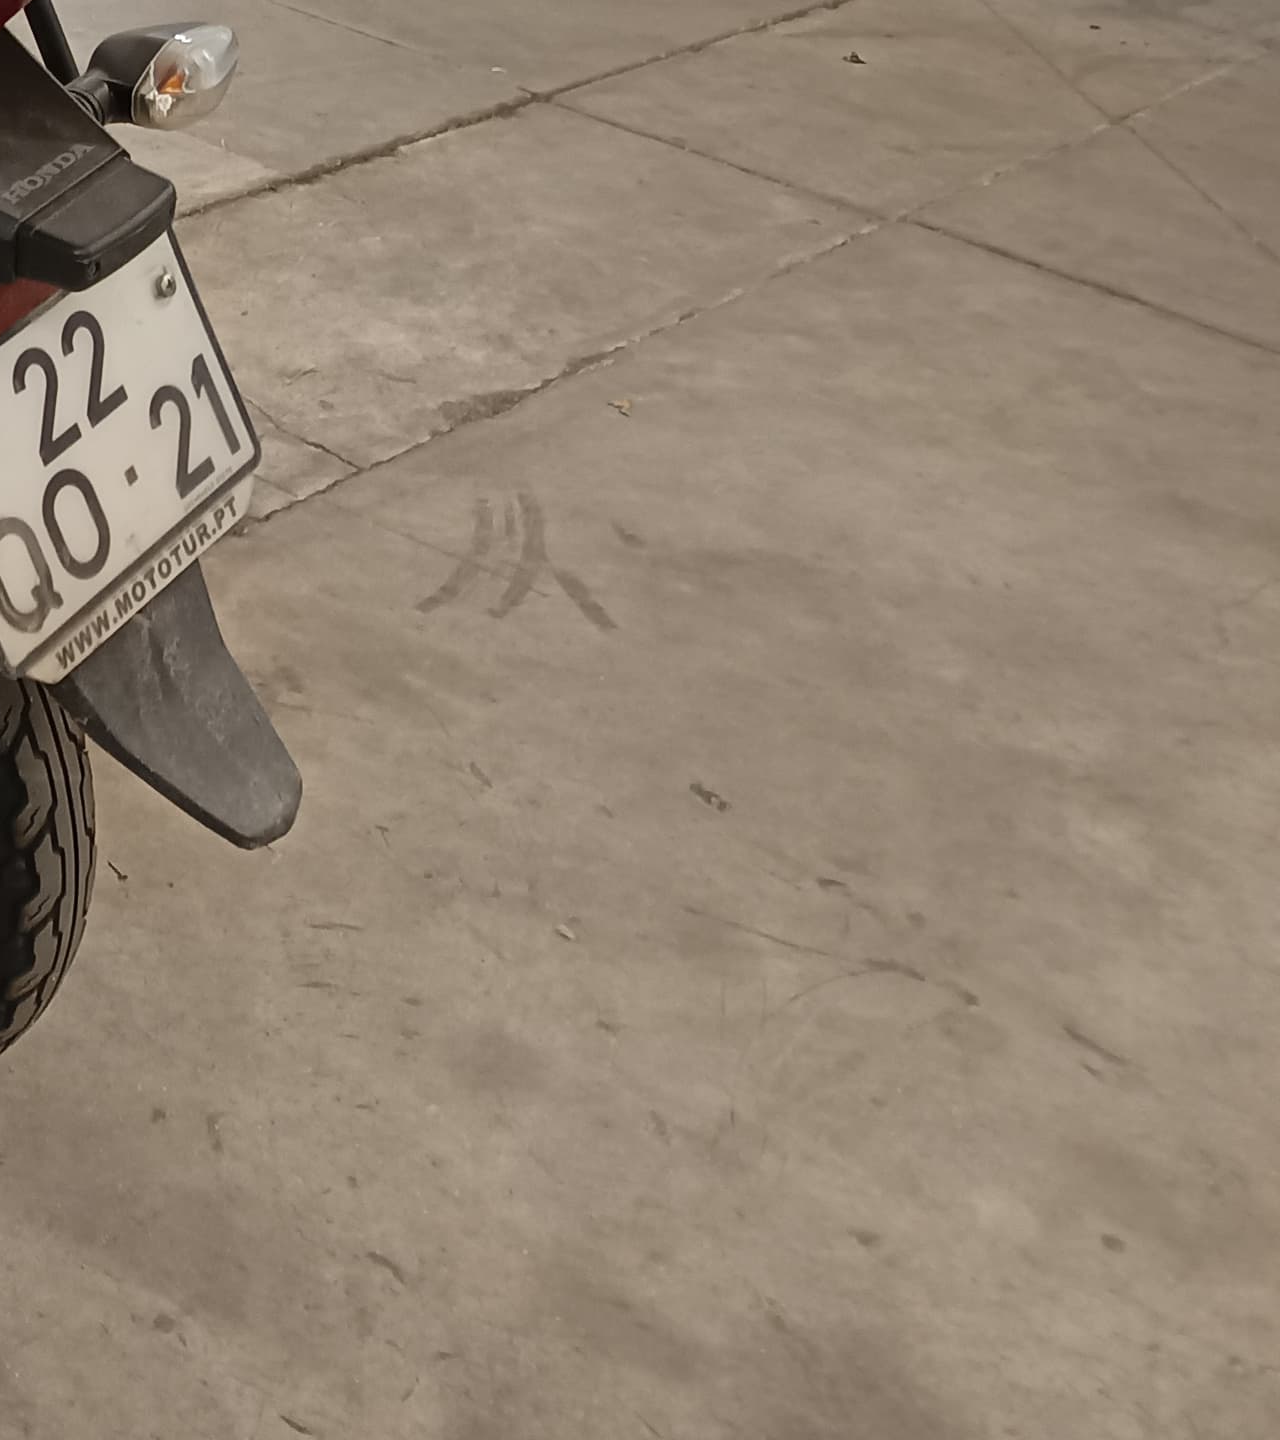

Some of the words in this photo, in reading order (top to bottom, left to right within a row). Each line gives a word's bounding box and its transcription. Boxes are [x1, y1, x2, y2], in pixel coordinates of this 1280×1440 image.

[1, 143, 96, 205] HONDA
[12, 310, 129, 468] 22
[54, 494, 238, 671] WWW.MOTOTUR.PT
